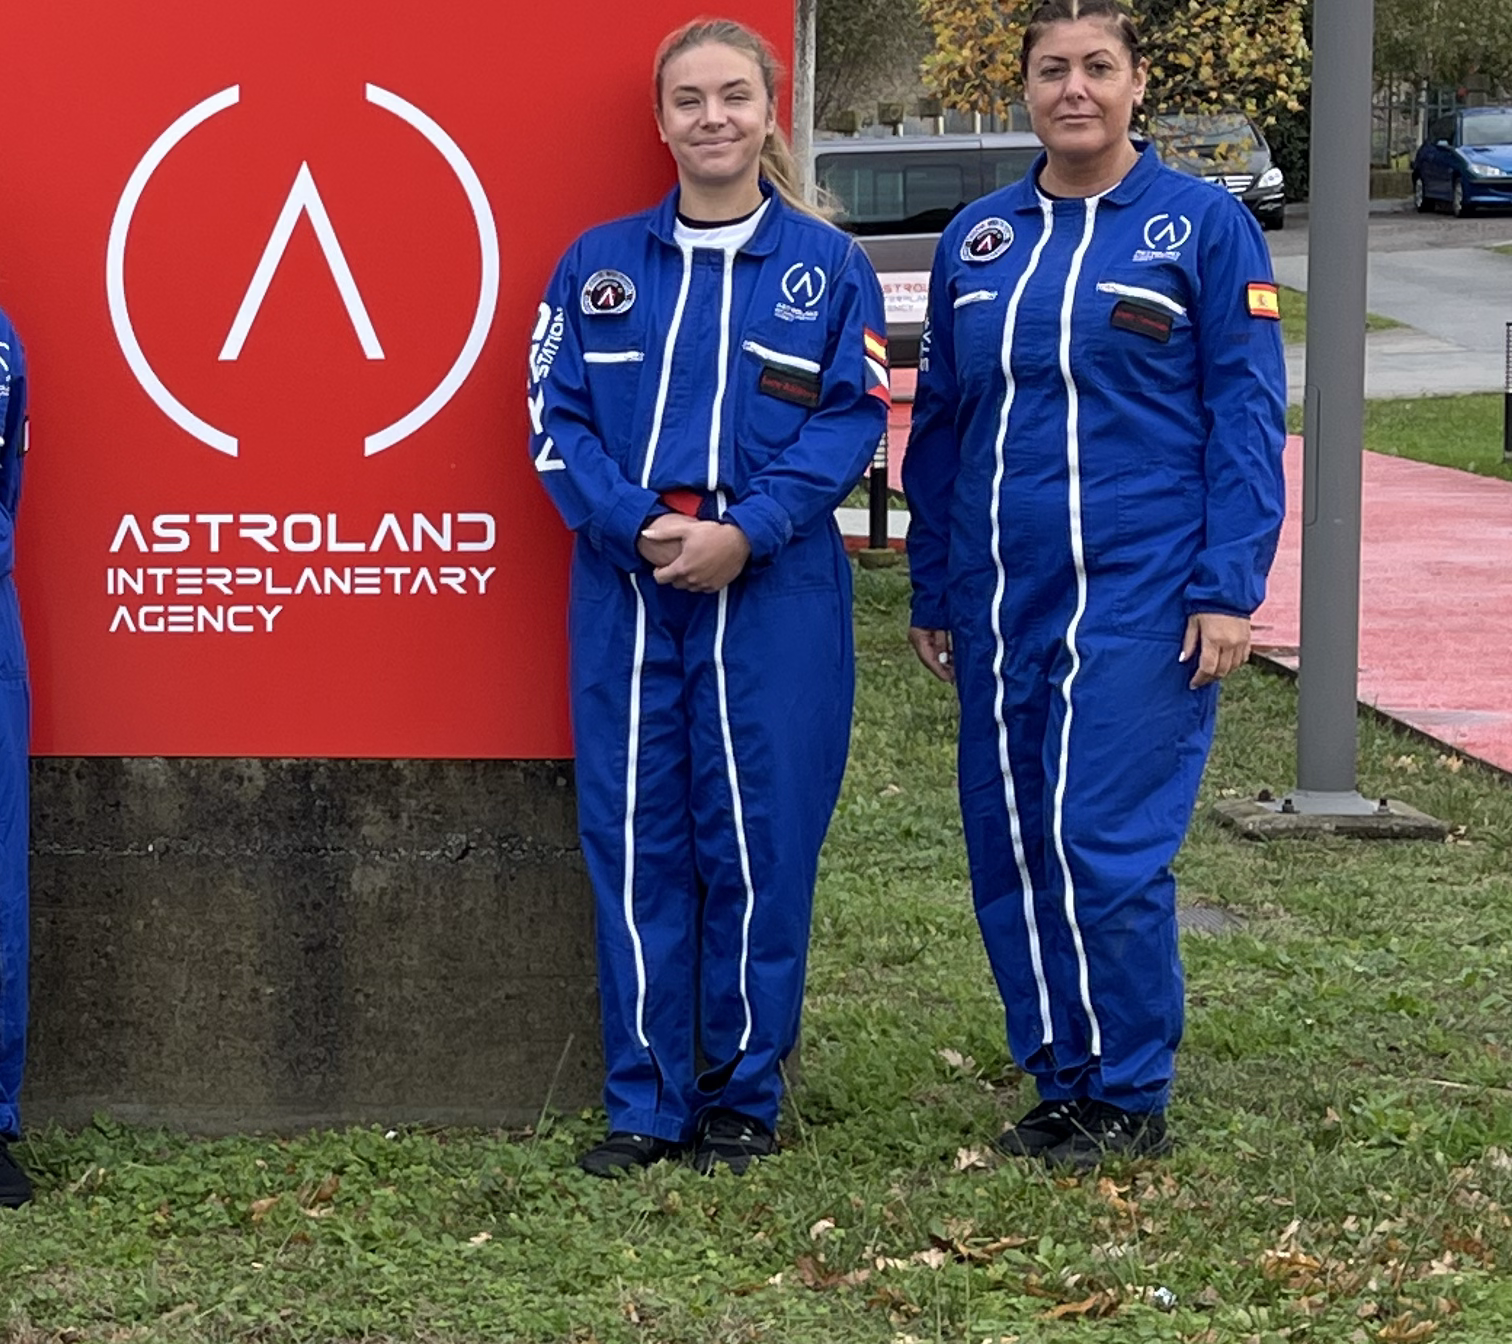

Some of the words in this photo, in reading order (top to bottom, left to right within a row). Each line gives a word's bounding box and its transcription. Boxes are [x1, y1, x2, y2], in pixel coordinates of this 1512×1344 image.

[883, 283, 927, 293] STROL
[536, 306, 565, 379] STATION
[108, 512, 497, 553] ASTROLAND
[107, 566, 497, 596] INTERPLANETARY
[108, 604, 284, 633] AGENCY
